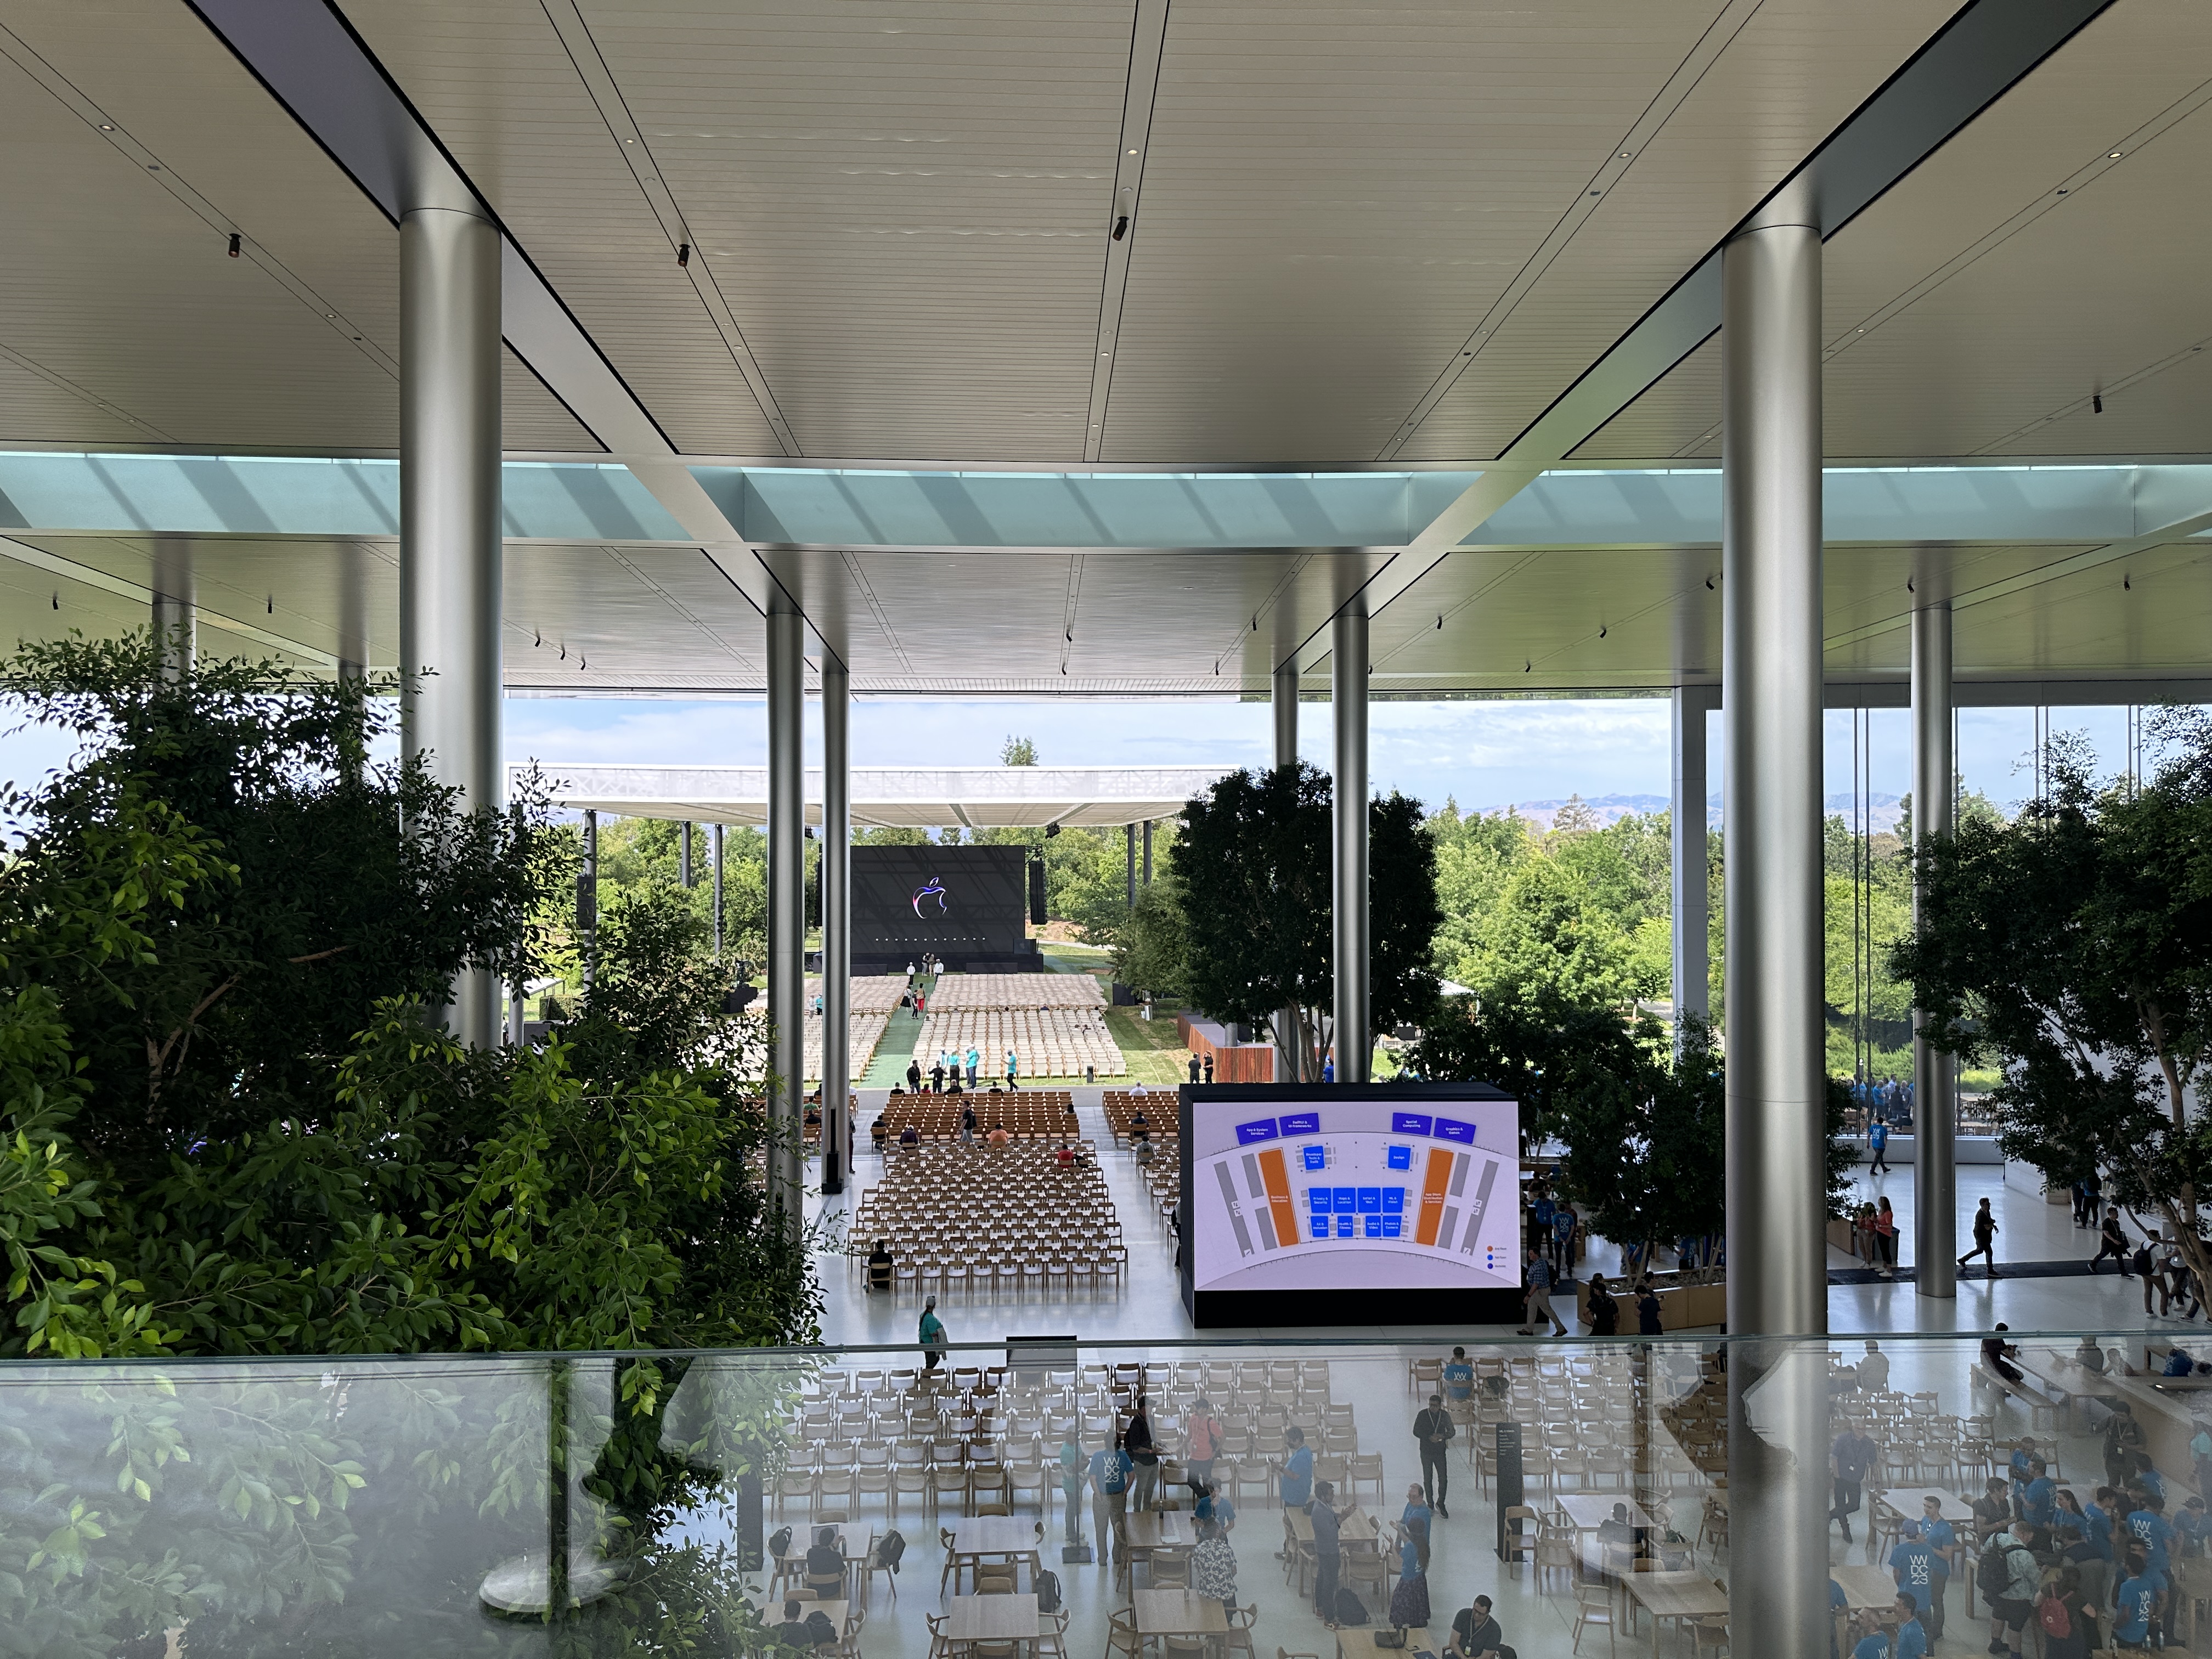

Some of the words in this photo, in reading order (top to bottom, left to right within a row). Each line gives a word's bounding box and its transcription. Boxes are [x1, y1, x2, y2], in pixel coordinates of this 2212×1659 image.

[1104, 1466, 1120, 1474] DC
[1105, 1474, 1119, 1483] 23
[2134, 1528, 2151, 1540] DC
[2144, 1539, 2154, 1549] 3
[1911, 1565, 1928, 1575] DC
[1911, 1575, 1928, 1584] 23
